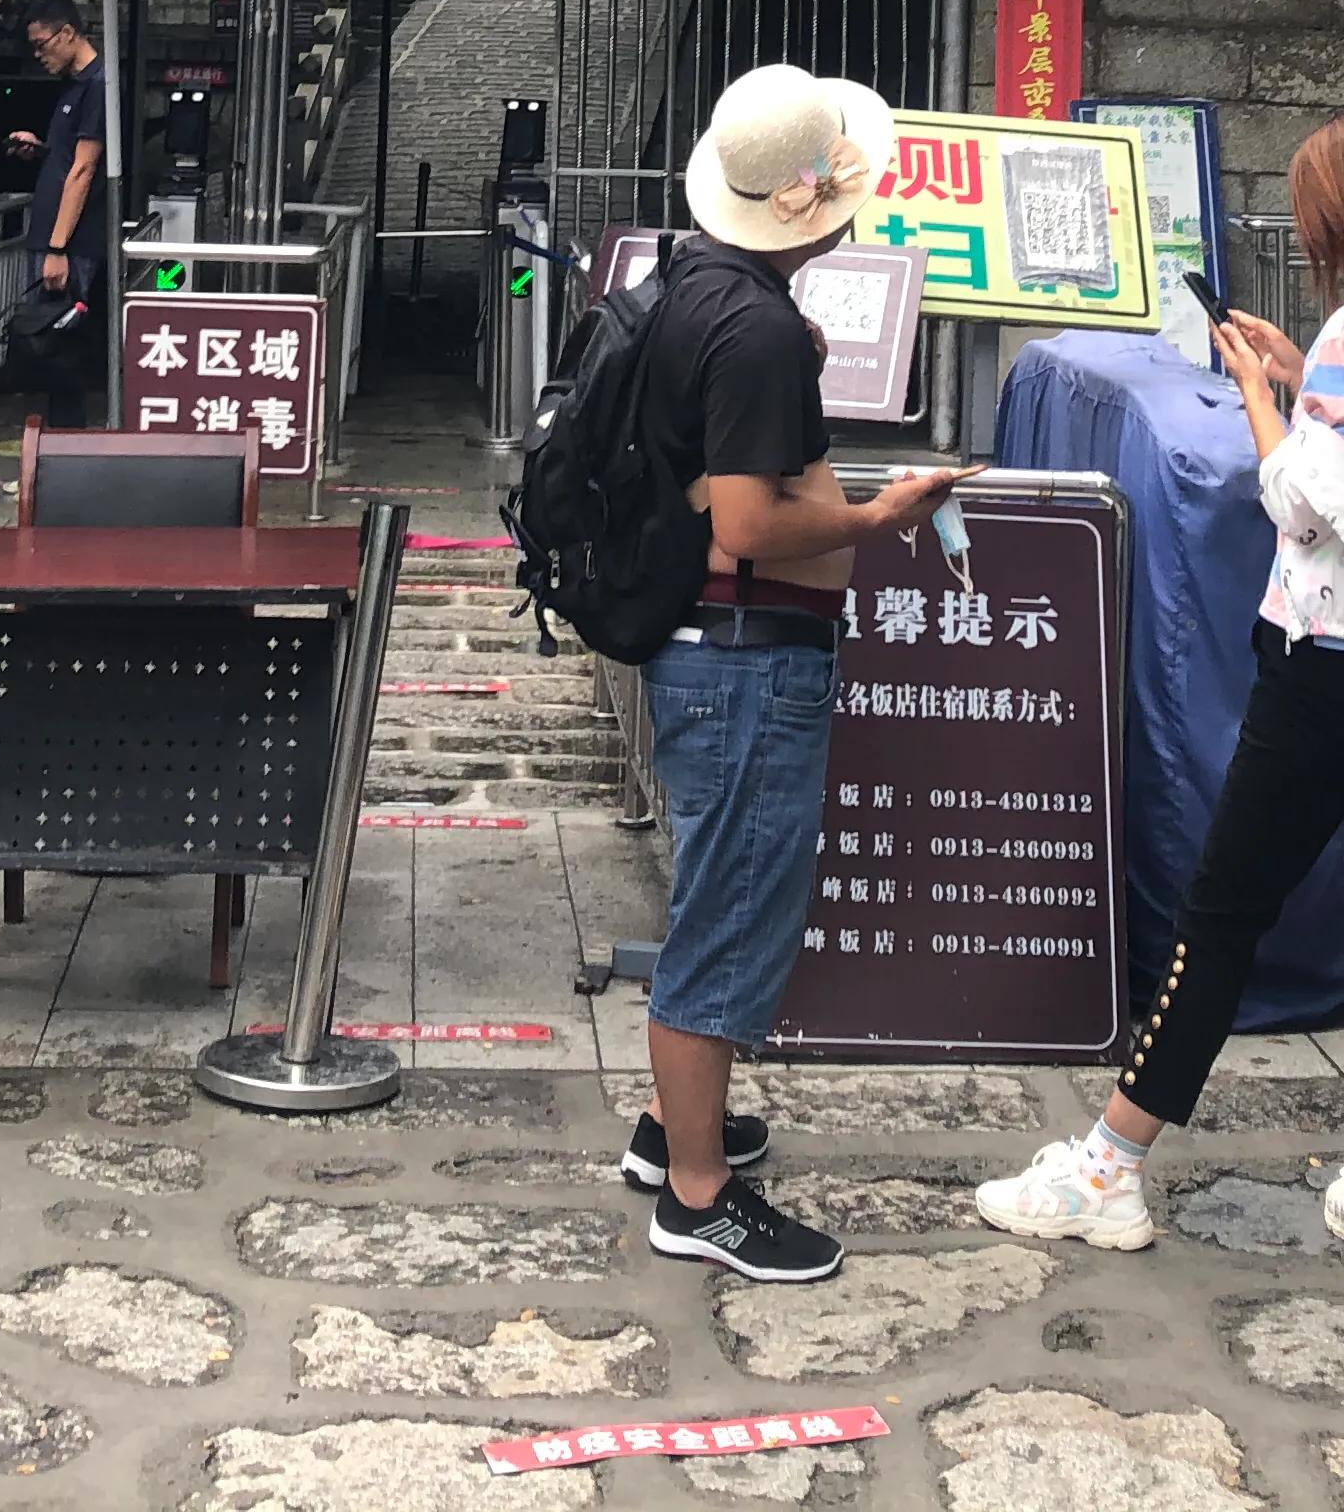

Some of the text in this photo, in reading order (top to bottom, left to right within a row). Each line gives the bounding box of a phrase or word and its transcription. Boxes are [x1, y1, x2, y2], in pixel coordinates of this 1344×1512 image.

[138, 324, 301, 381] 本区域
[139, 396, 296, 451] 已消毒
[822, 783, 1093, 813] 饭店： 0913-4301312
[931, 837, 1094, 860] 0913-4360993
[931, 883, 1097, 907] 0913-4360992
[932, 934, 1096, 958] 0913-4360991
[532, 1415, 844, 1464] 防疫安全距离线
